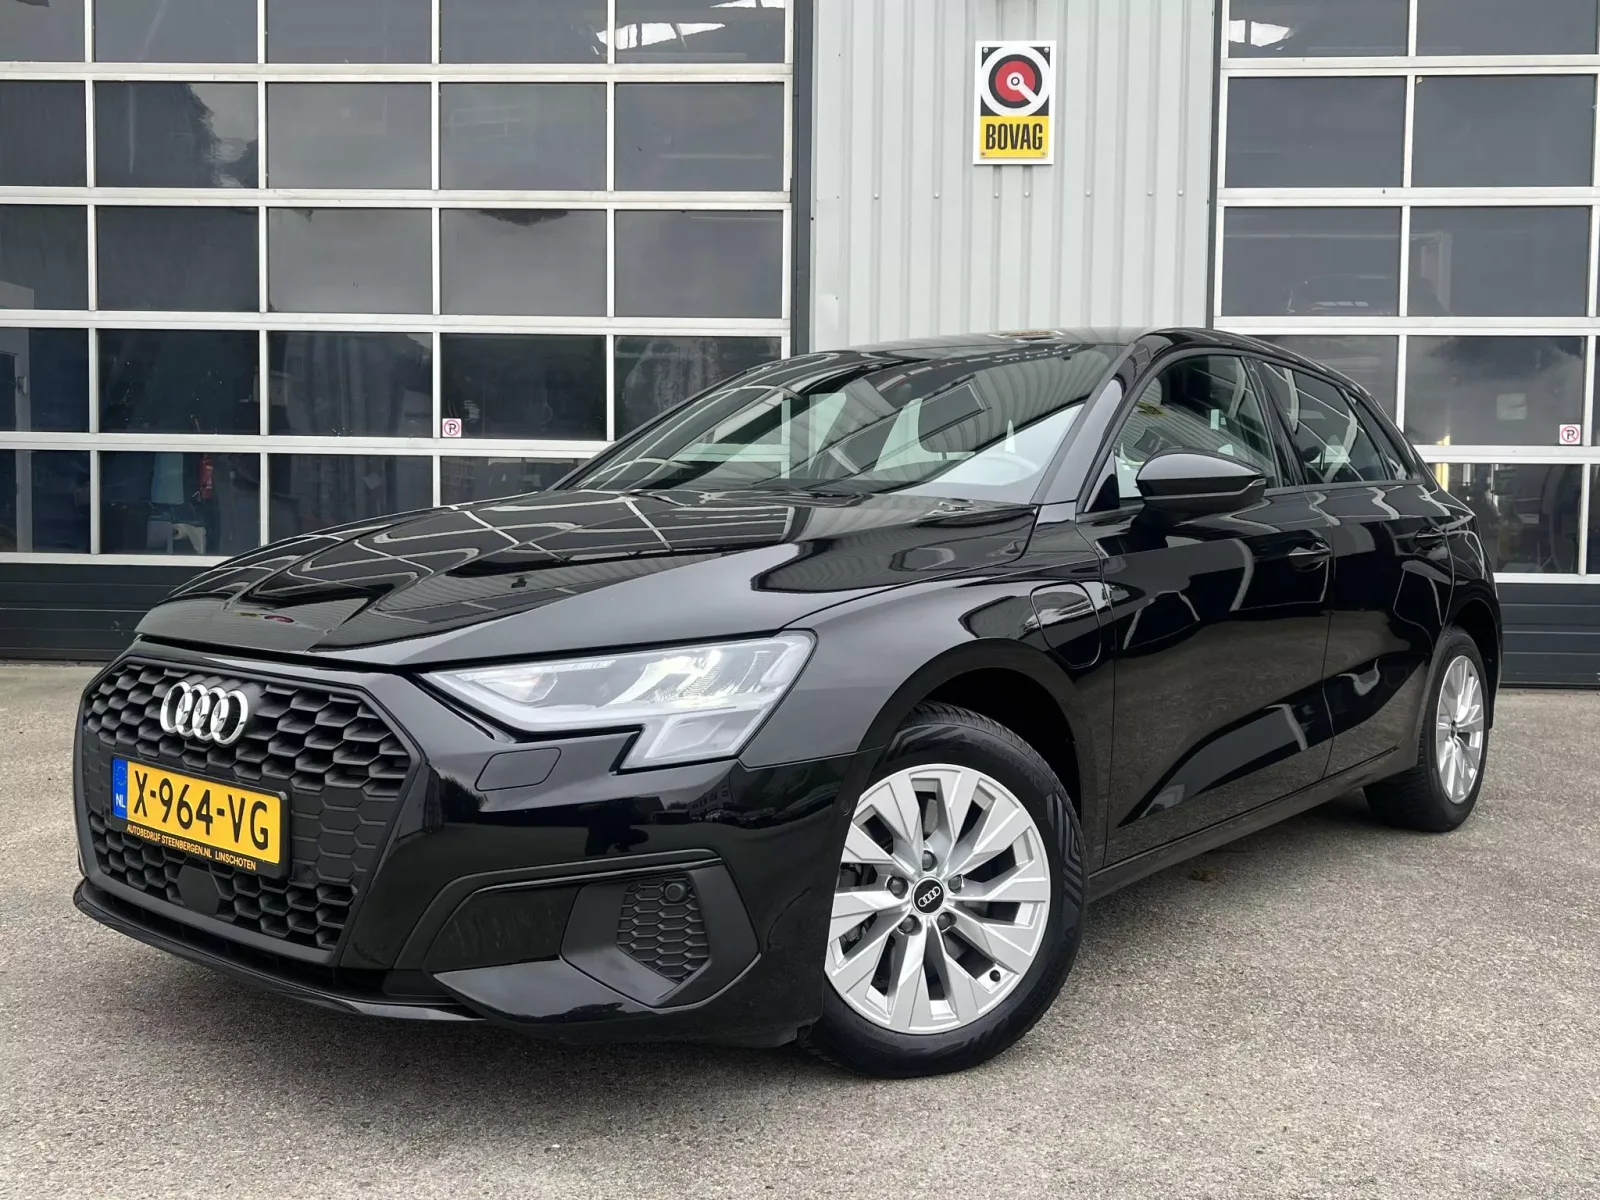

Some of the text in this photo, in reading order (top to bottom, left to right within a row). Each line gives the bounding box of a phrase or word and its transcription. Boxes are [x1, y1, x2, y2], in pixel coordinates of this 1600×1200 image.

[985, 123, 1043, 150] BOVAG
[115, 793, 126, 809] NL
[133, 770, 269, 851] X-964-VG
[126, 825, 257, 871] AUTOBEDRIJF STEENBERGEN.NL LINSCHOTEN
